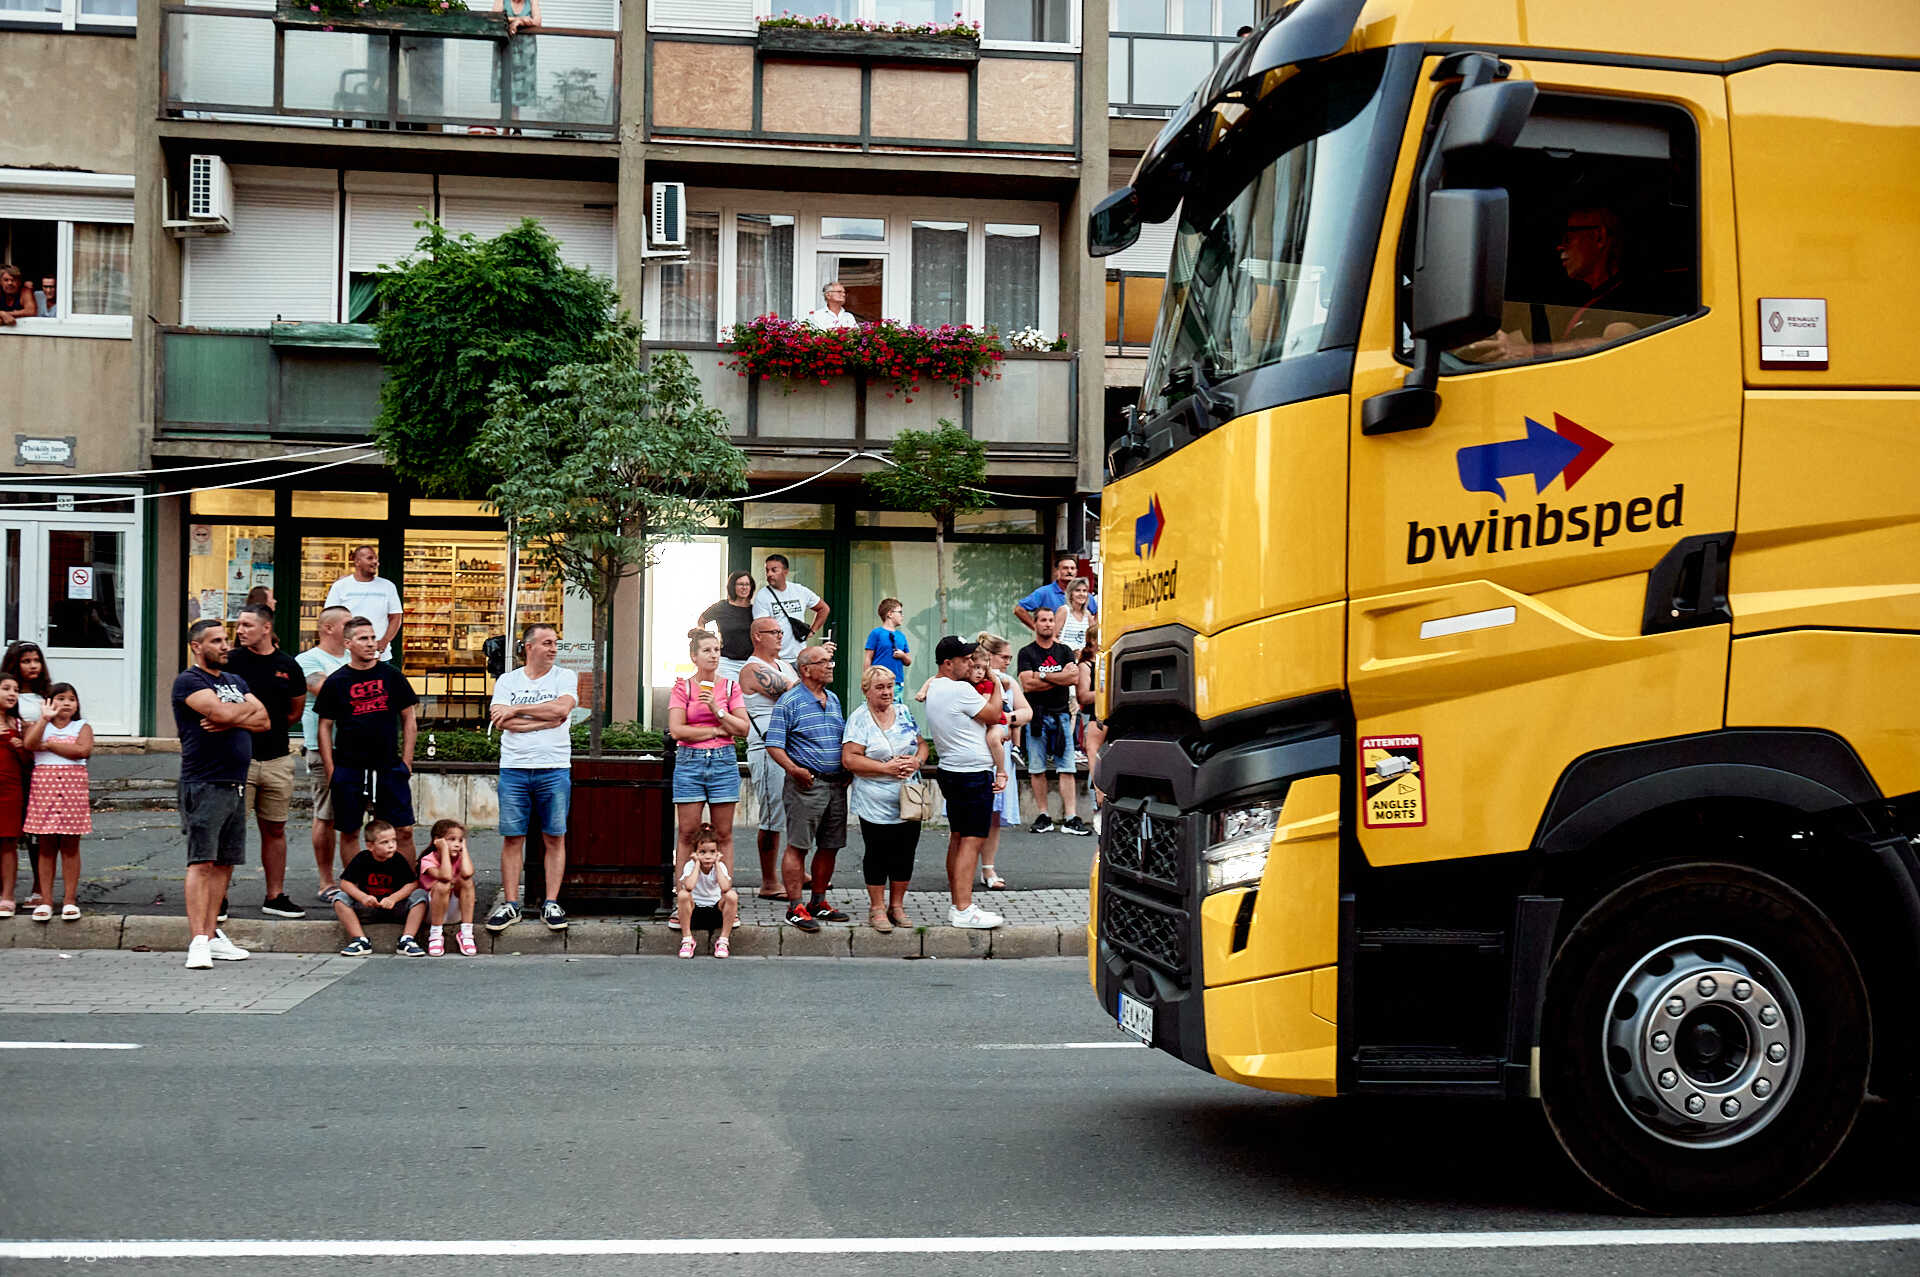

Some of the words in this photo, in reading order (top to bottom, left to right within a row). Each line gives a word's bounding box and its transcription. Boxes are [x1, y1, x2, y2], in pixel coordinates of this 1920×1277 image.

[1406, 484, 1685, 566] bwinbsped
[1122, 560, 1178, 611] bwinbsped
[1038, 664, 1063, 673] adidas
[1363, 737, 1419, 748] ATTENTION
[1372, 799, 1417, 810] ANGLES
[1375, 809, 1416, 820] MORTS
